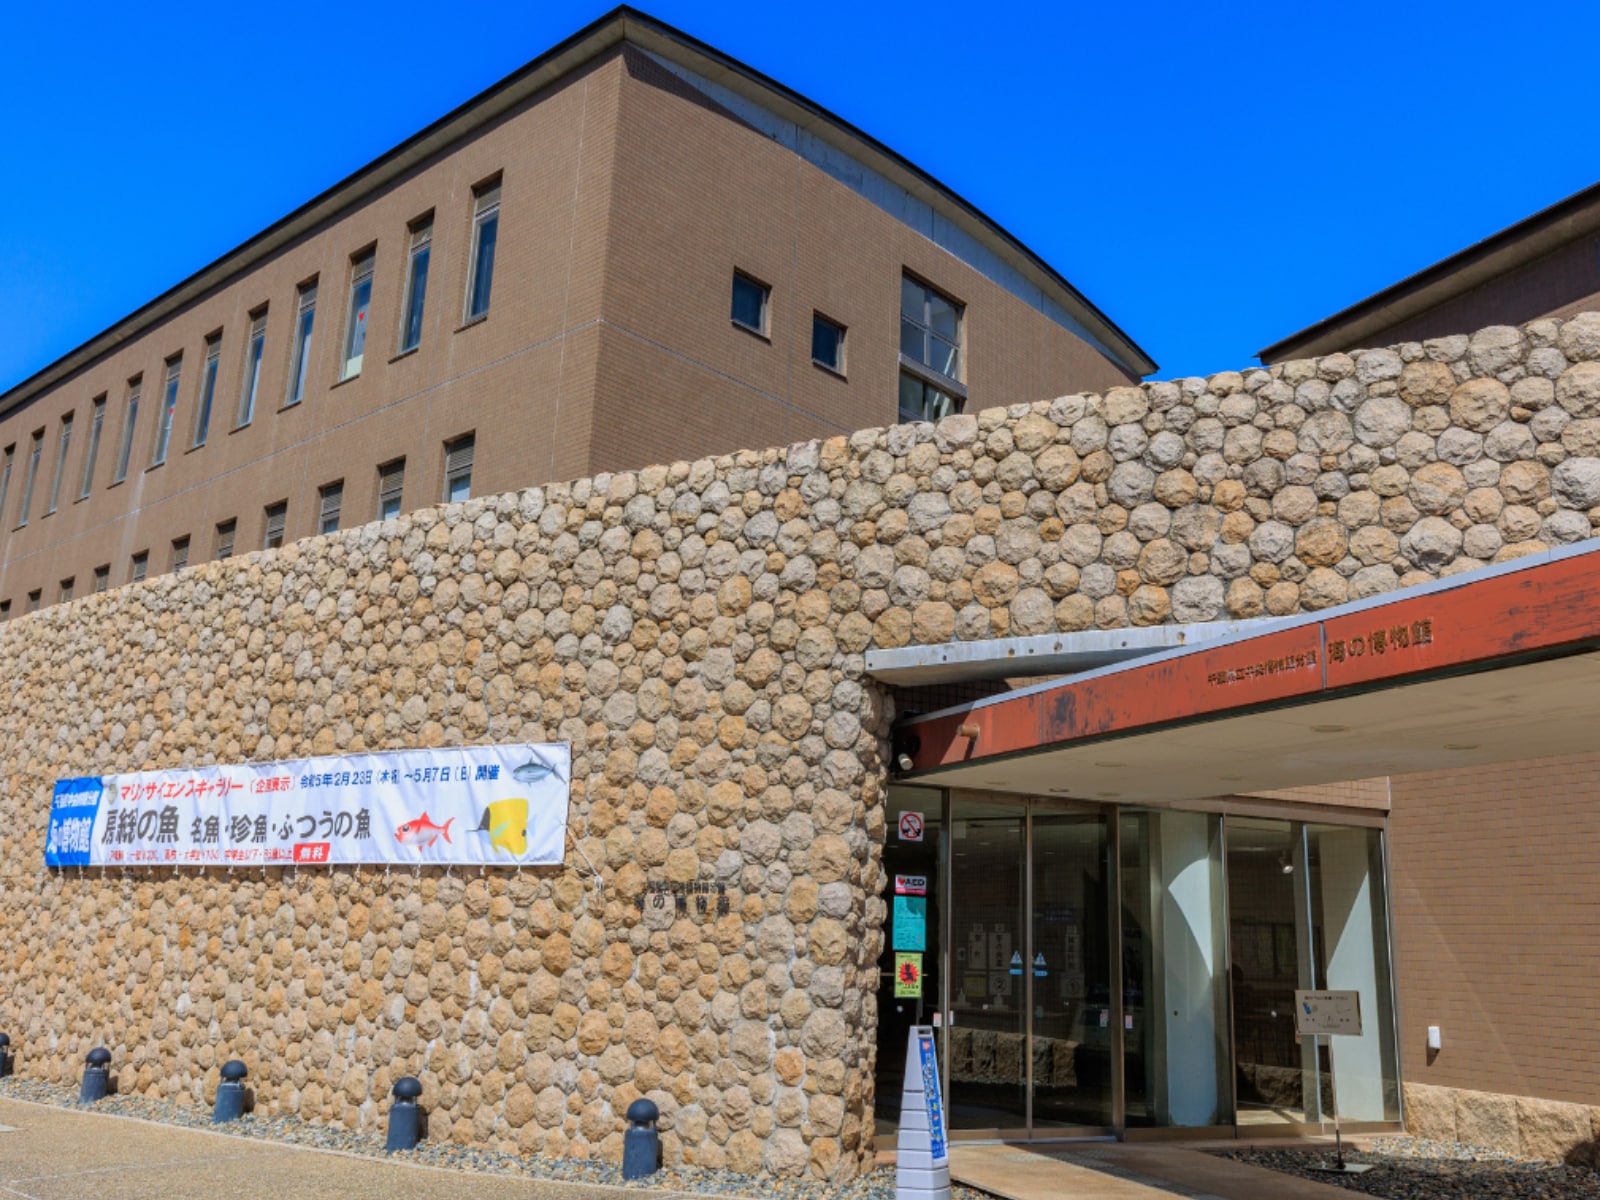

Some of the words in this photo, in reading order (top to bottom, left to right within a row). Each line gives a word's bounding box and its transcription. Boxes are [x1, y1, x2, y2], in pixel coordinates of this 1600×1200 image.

[1328, 618, 1433, 664] 海の博物館
[101, 804, 180, 845] 房総の魚
[299, 846, 325, 860] 無料
[904, 877, 925, 887] AED
